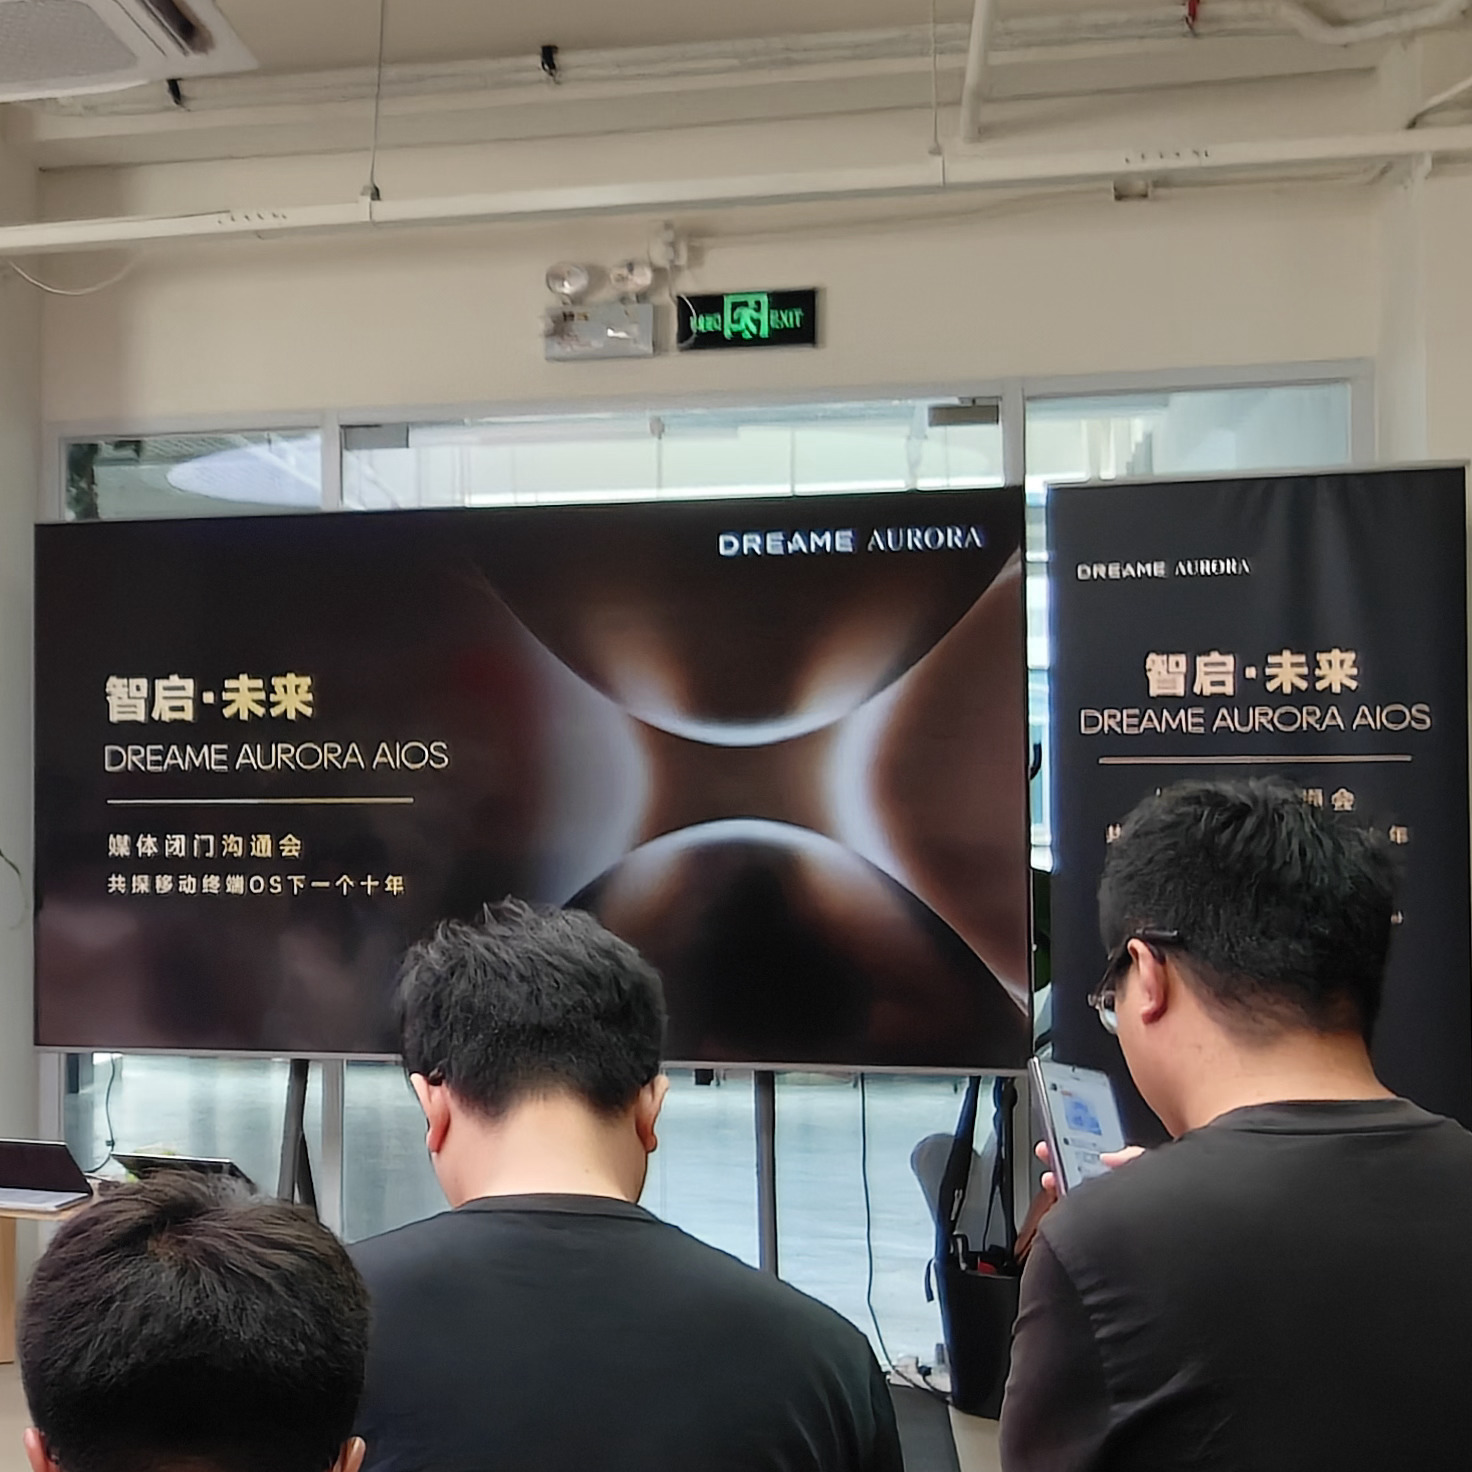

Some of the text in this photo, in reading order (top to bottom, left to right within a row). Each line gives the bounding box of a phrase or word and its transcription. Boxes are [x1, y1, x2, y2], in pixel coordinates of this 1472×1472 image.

[718, 526, 983, 556] DREAME AURORA
[1077, 561, 1166, 580] DREAME
[1146, 648, 1359, 697] 智启·未来
[105, 672, 314, 723] 智启·未来
[1079, 703, 1432, 735] DREAME AURORA AIOS
[104, 741, 450, 773] DREAME AURORA AIOS
[108, 833, 303, 858] 媒体闭门沟通会
